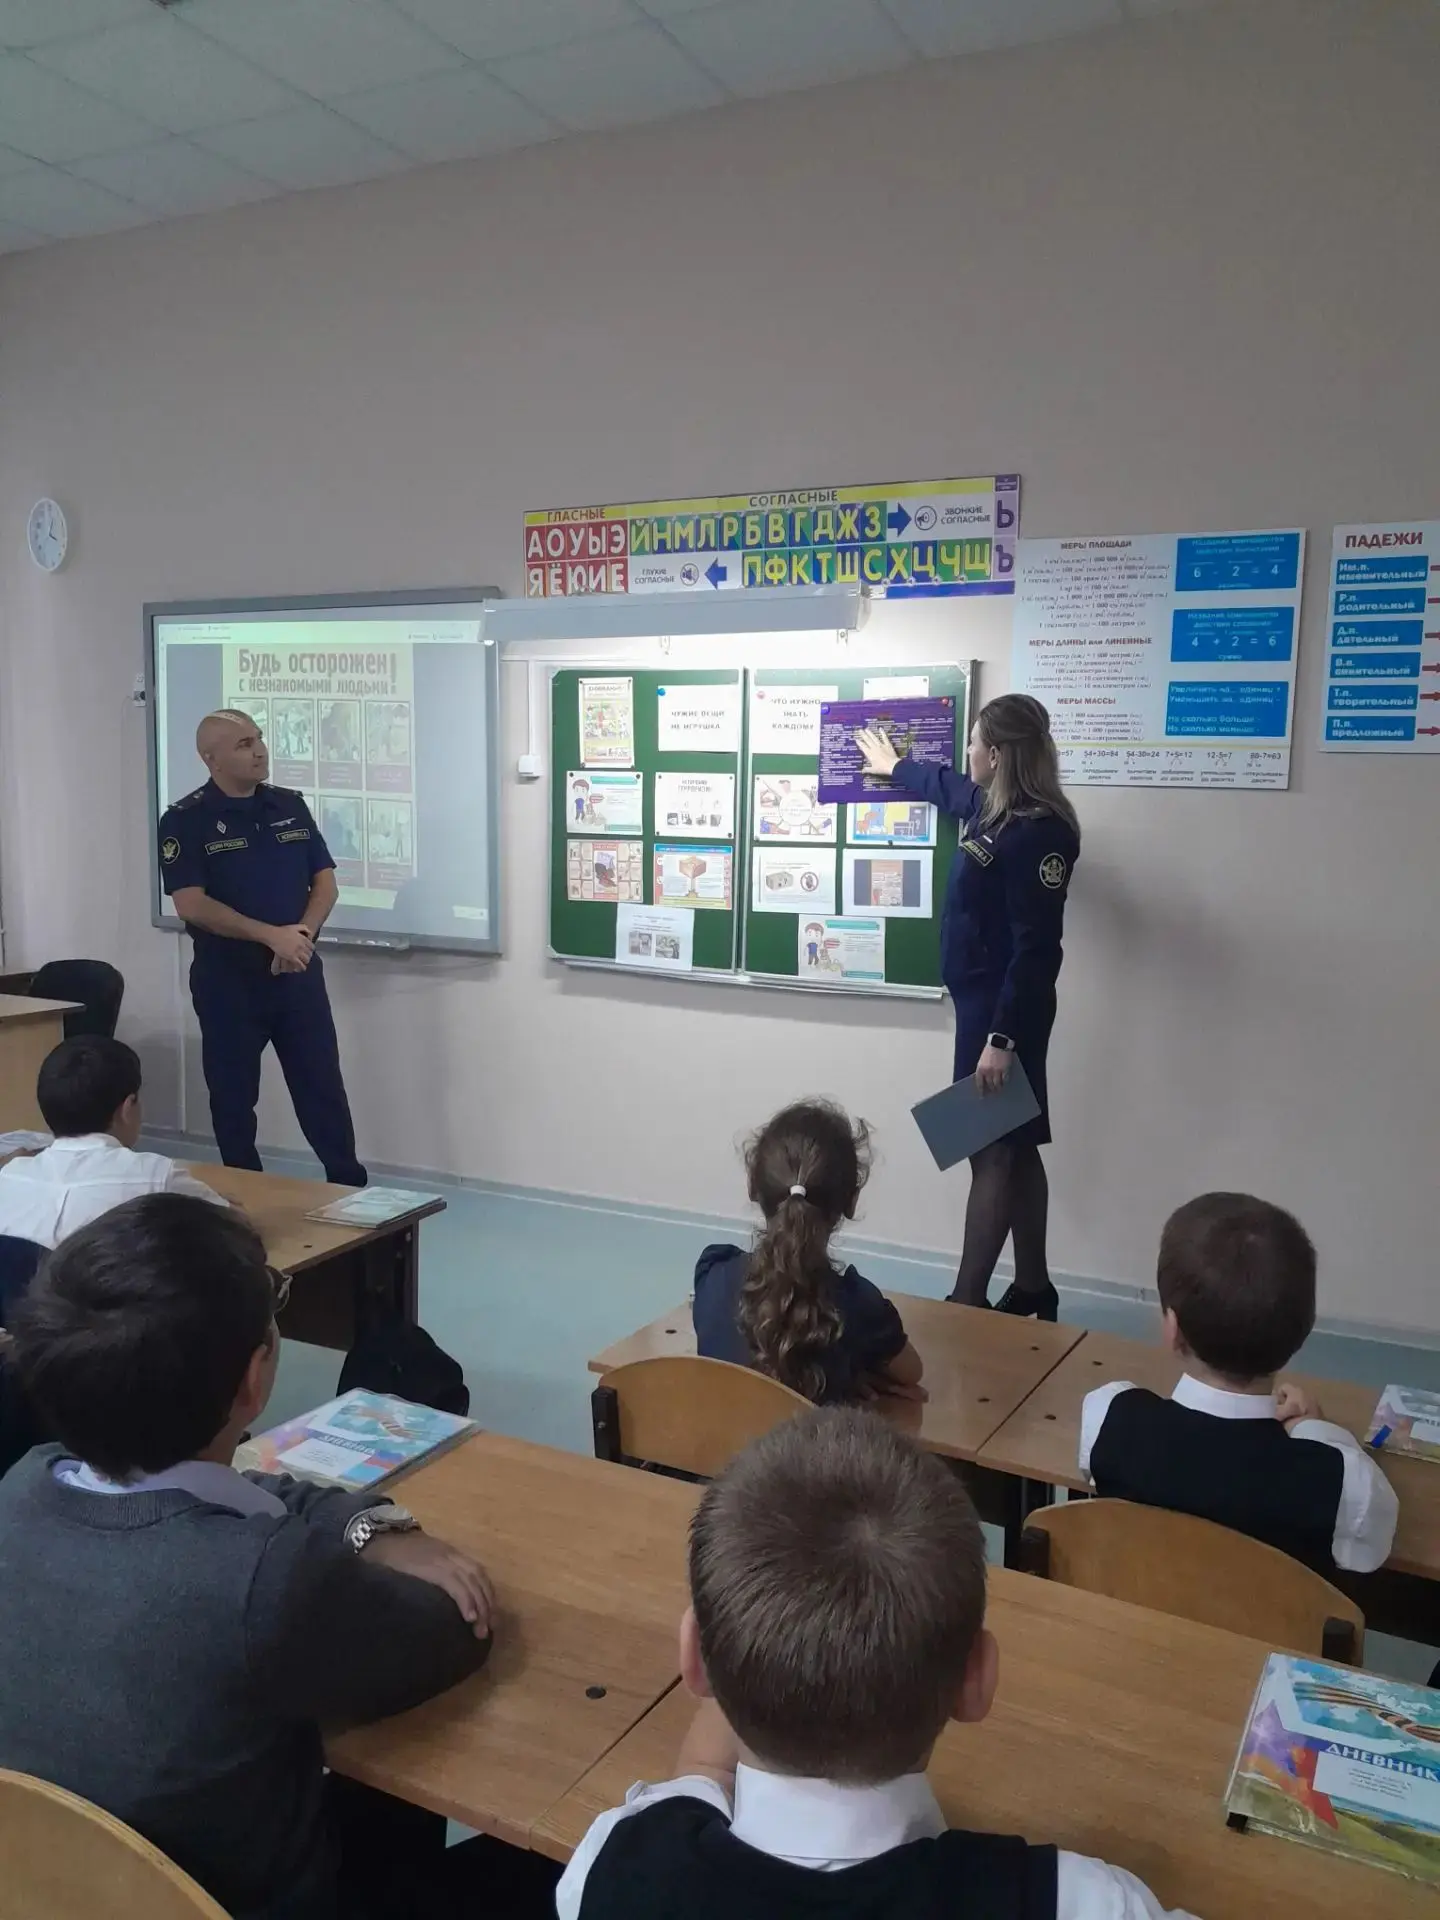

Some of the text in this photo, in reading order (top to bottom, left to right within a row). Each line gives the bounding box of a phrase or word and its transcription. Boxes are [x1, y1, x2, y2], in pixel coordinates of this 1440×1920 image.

[750, 489, 838, 507] СОГЛАСНЫЕ
[547, 508, 606, 523] ГЛАСНЫЕ
[945, 505, 983, 515] ЗВОНКИЕ
[941, 514, 991, 525] СОГЛАСНЫЕ
[1061, 540, 1132, 550] МЕРЫ ПЛОЩАДИ
[1345, 532, 1424, 549] ПАДЕЖИ
[1193, 566, 1201, 578] 6
[1232, 565, 1240, 577] 2
[1271, 564, 1279, 575] 4
[634, 575, 676, 585] СОГЛАСНЫЕ
[1338, 600, 1416, 612] родительный
[1029, 639, 1054, 647] МЕРЫ
[1192, 636, 1199, 647] 4
[1231, 635, 1239, 647] 2
[1268, 635, 1276, 647] 6
[239, 649, 281, 677] Будь
[239, 680, 245, 692] с
[249, 678, 332, 694] незнакомыми
[1057, 697, 1083, 705] МЕРЫ
[1126, 750, 1160, 758] 54-30=24
[1207, 751, 1233, 760] 12-5=7
[1326, 1743, 1440, 1782] ДНЕВНИК
